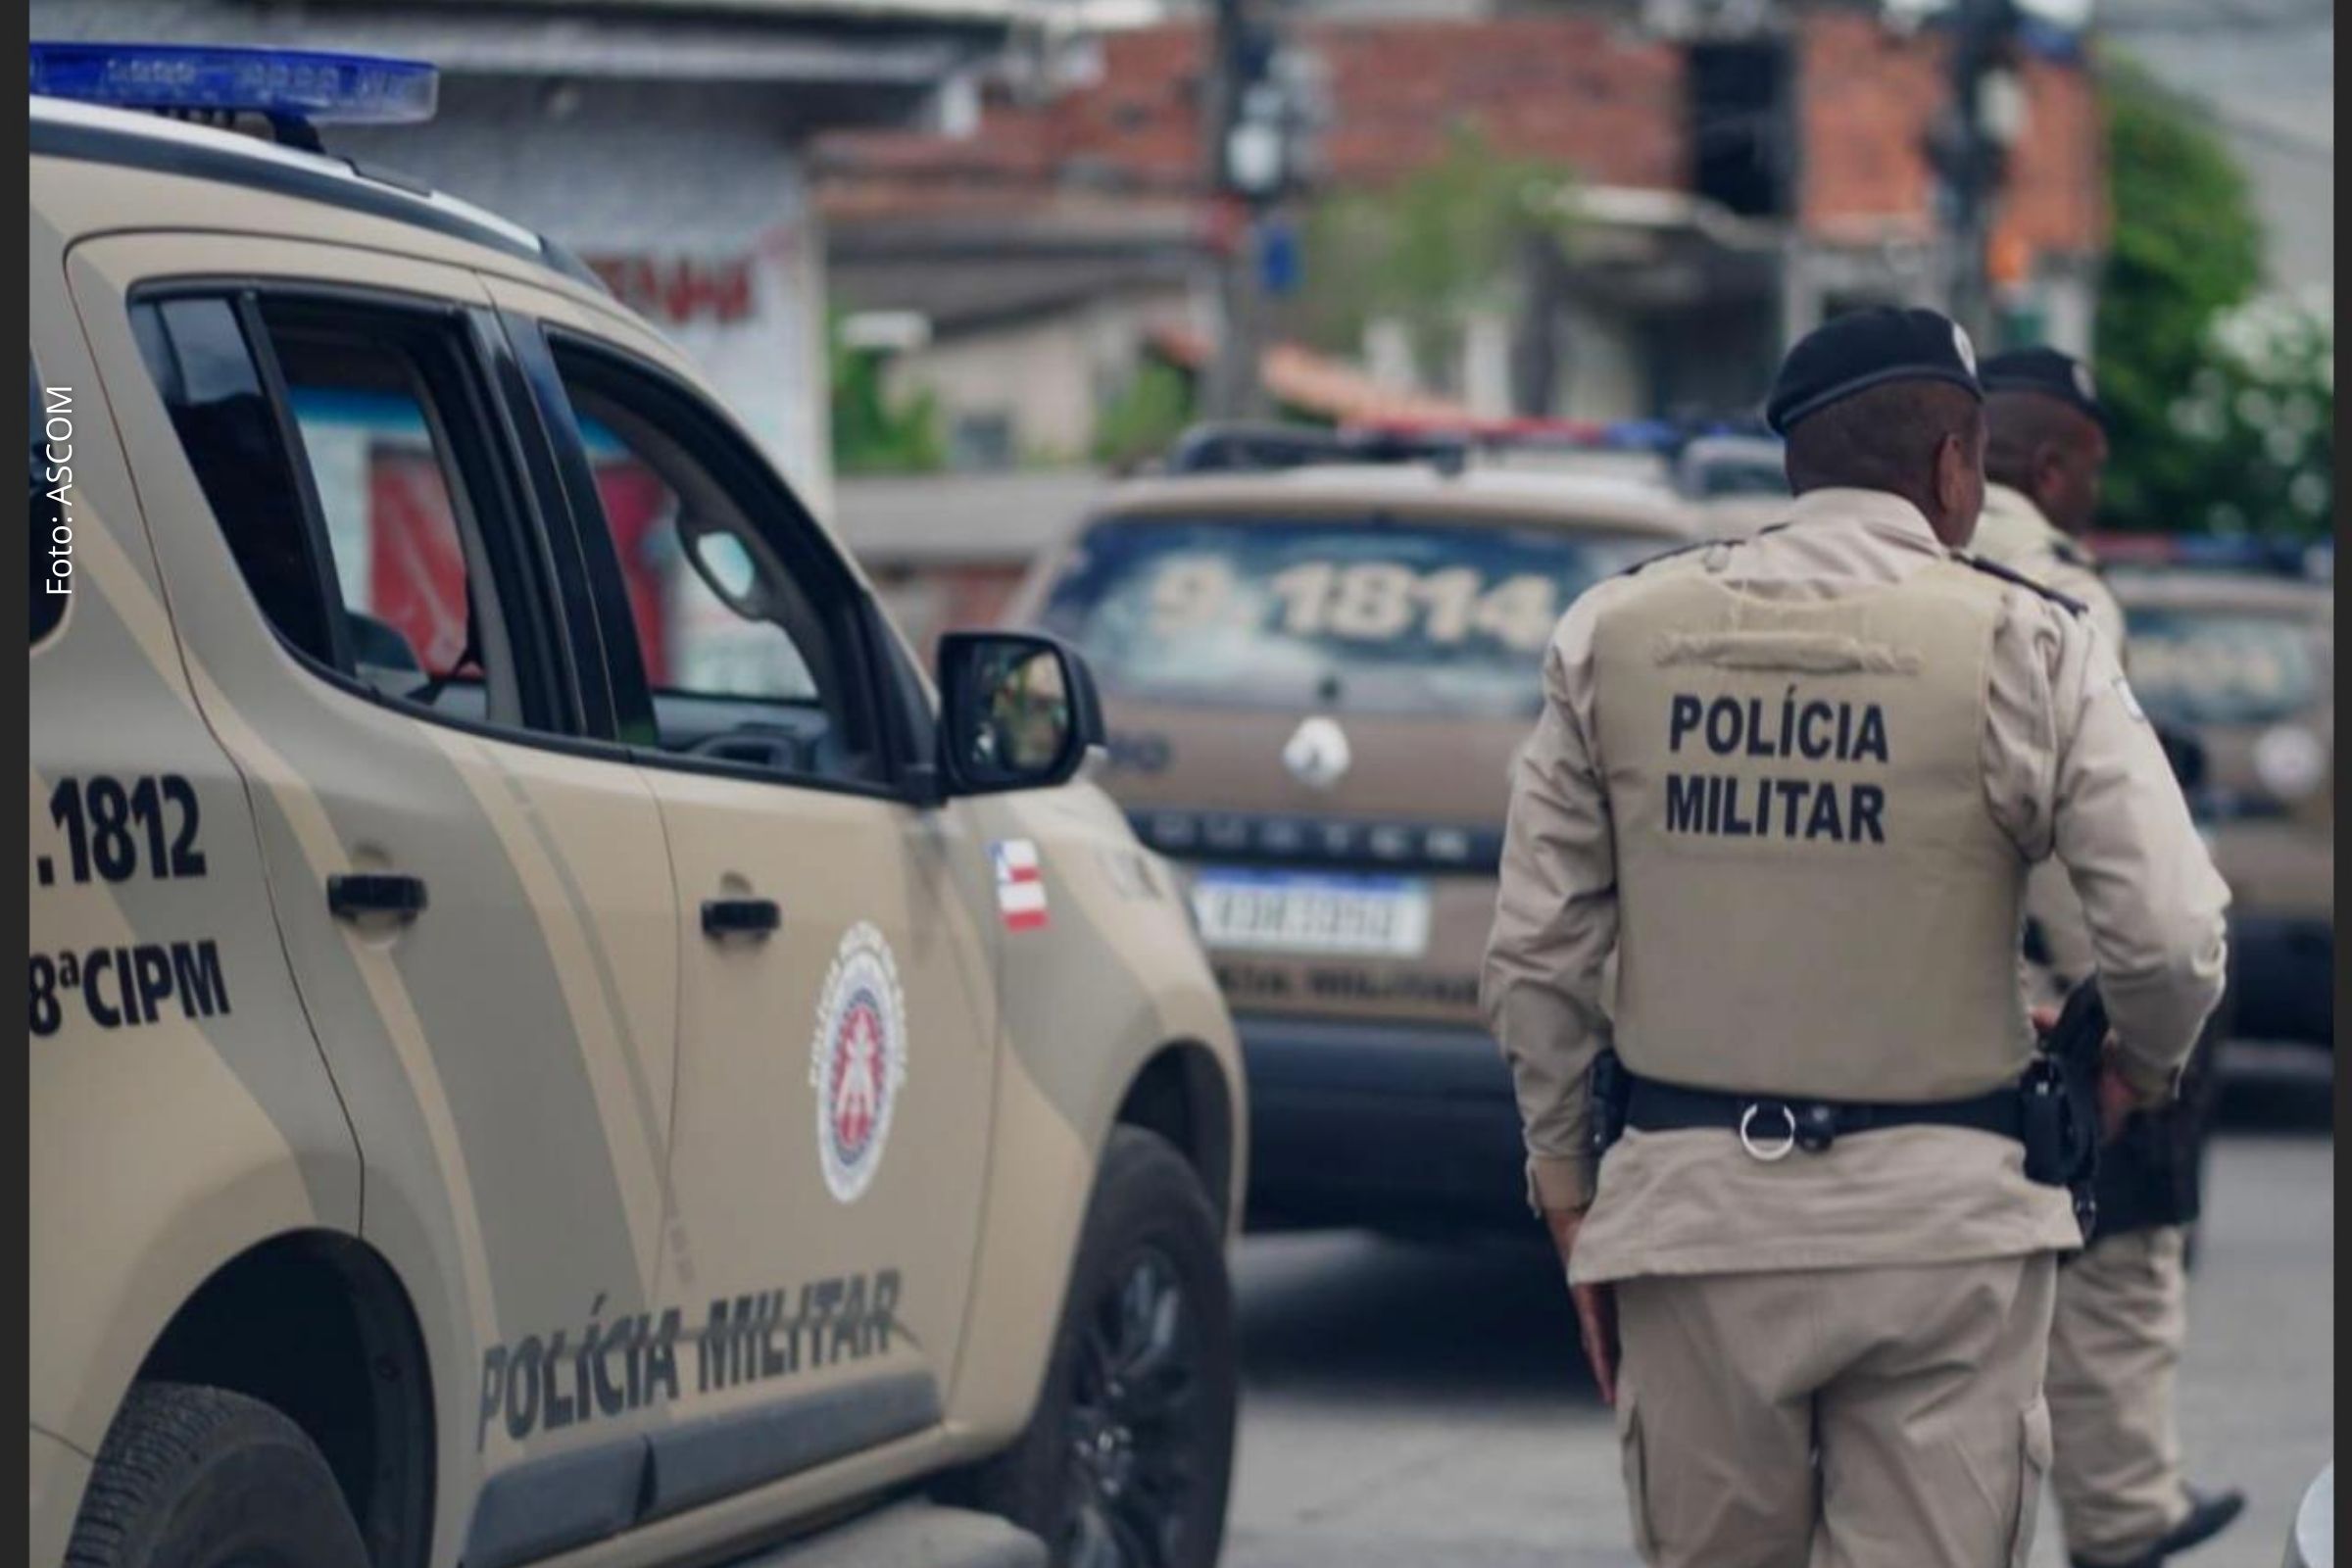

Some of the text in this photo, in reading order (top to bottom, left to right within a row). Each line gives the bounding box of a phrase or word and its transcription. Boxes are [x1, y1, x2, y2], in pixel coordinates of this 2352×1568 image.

[1670, 684, 1888, 762] POLÍCIA
[1666, 774, 1886, 843] MILITAR
[477, 1268, 901, 1452] POLÍCIA MILITAR
